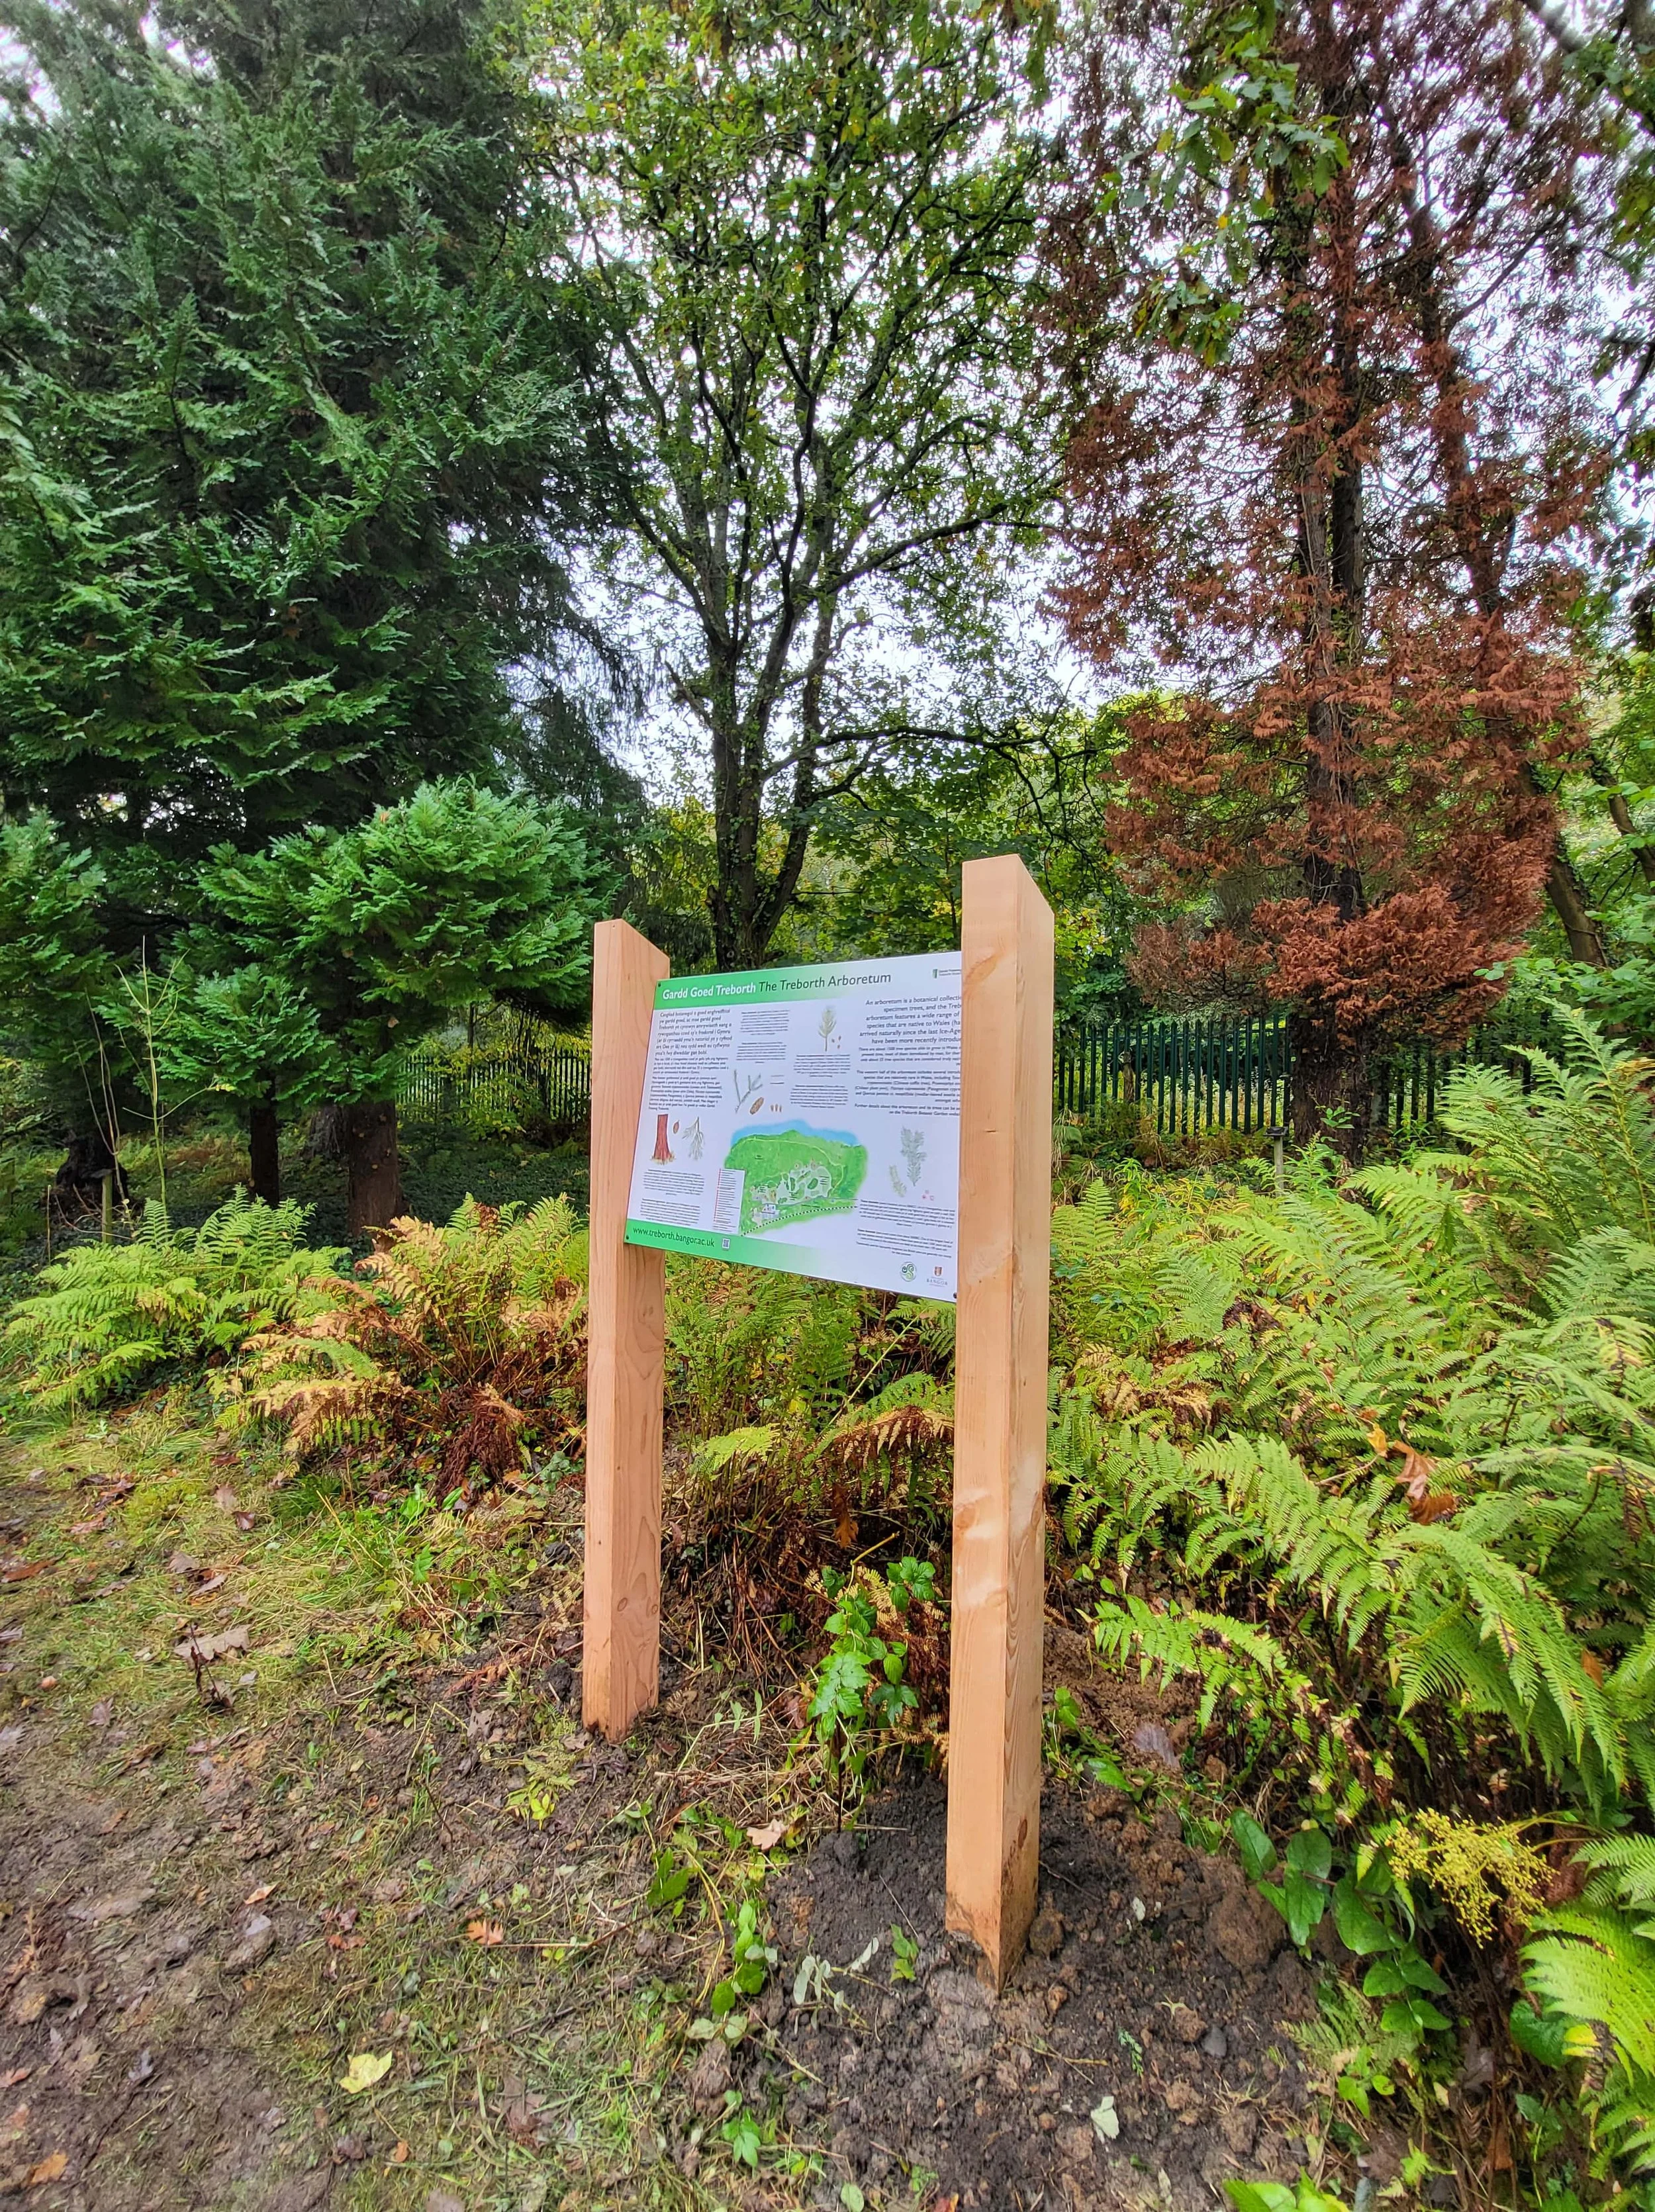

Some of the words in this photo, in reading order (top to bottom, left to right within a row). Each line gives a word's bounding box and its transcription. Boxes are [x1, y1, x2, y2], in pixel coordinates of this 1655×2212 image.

[663, 987, 688, 999] Gardd
[690, 984, 713, 997] Goed
[716, 982, 755, 995] Treborth
[759, 981, 777, 991] The
[780, 976, 825, 991] Treborth
[828, 974, 891, 986] Arboretum
[634, 1228, 715, 1247] www.treborth.bangor.ac.uk
